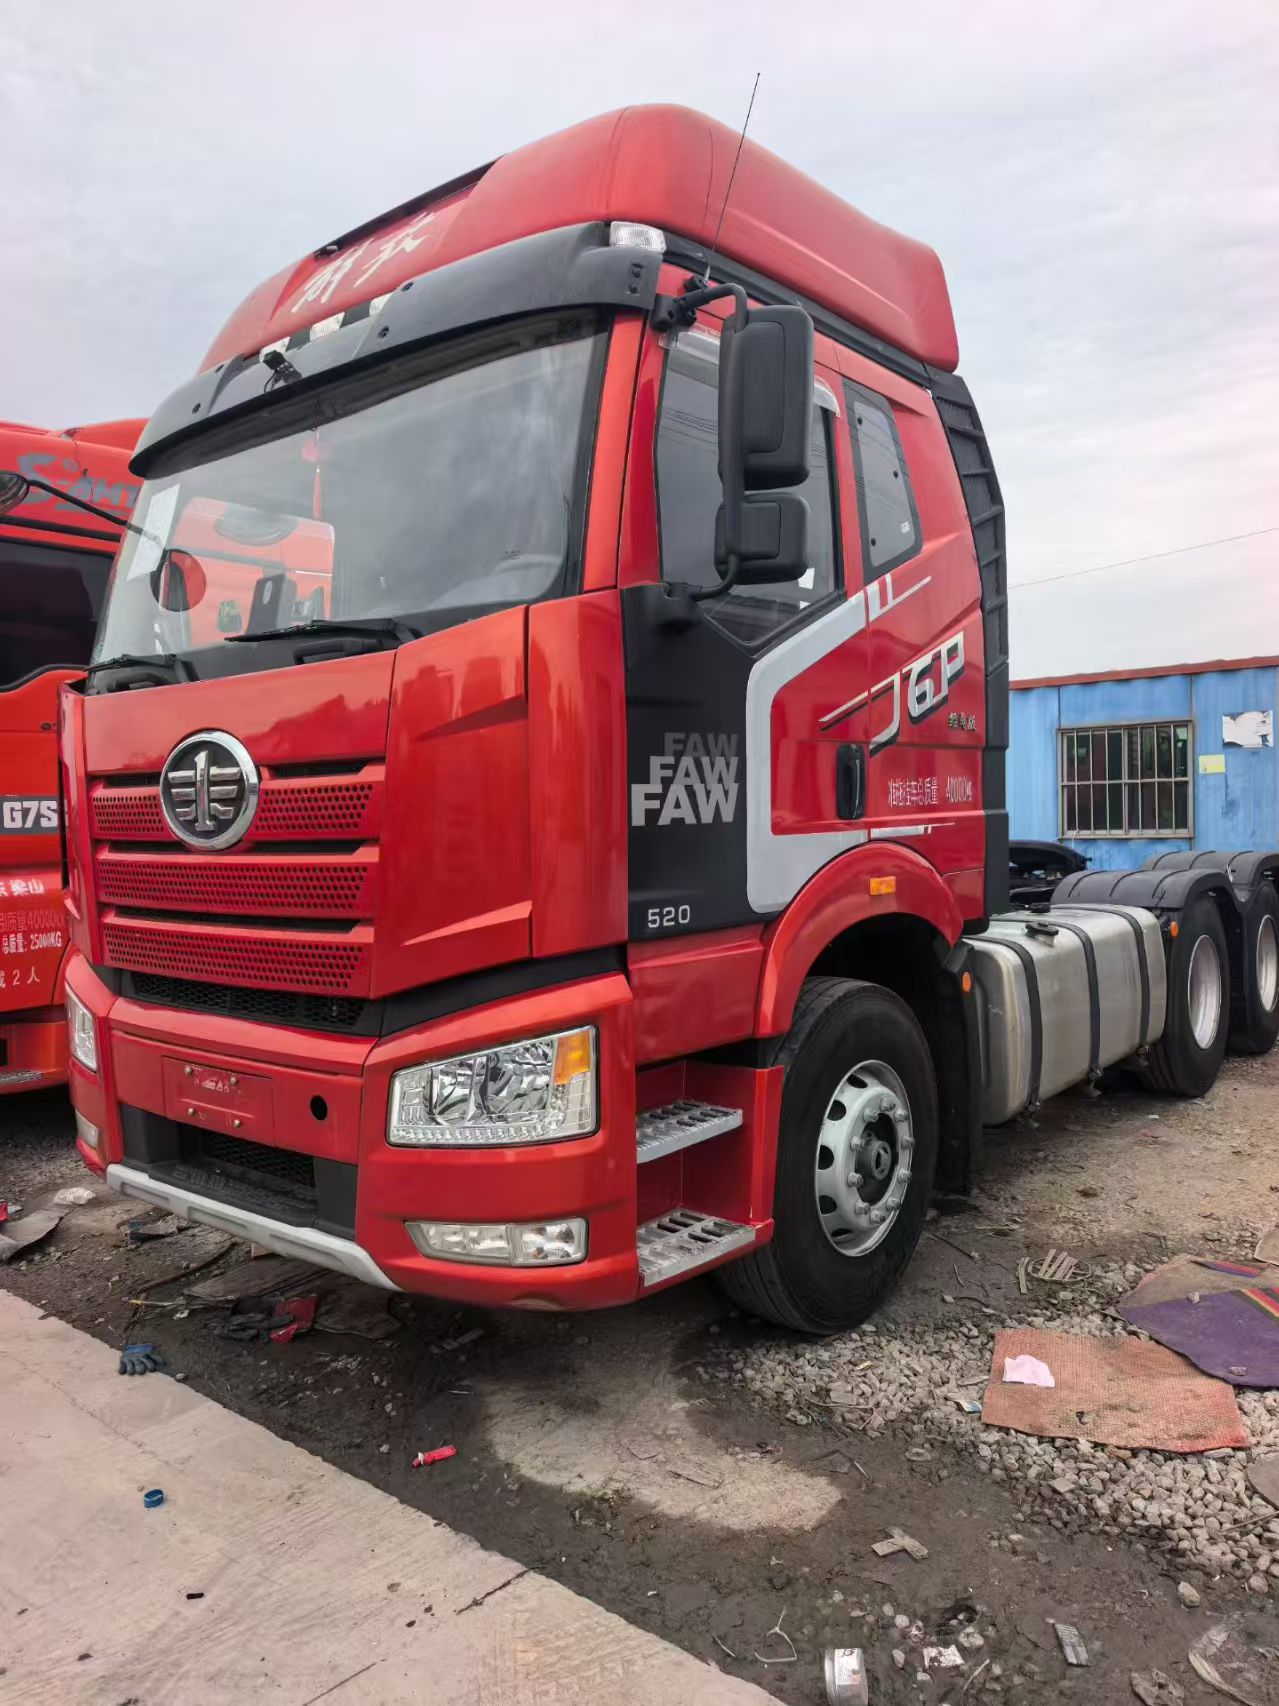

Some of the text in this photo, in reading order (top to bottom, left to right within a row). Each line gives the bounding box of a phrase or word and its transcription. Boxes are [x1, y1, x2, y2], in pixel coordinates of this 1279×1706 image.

[850, 632, 965, 754] J6P
[664, 732, 739, 763] FAW
[650, 755, 739, 791] FAW
[3, 799, 58, 829] G7S
[631, 783, 740, 827] FAW
[647, 904, 691, 928] 520
